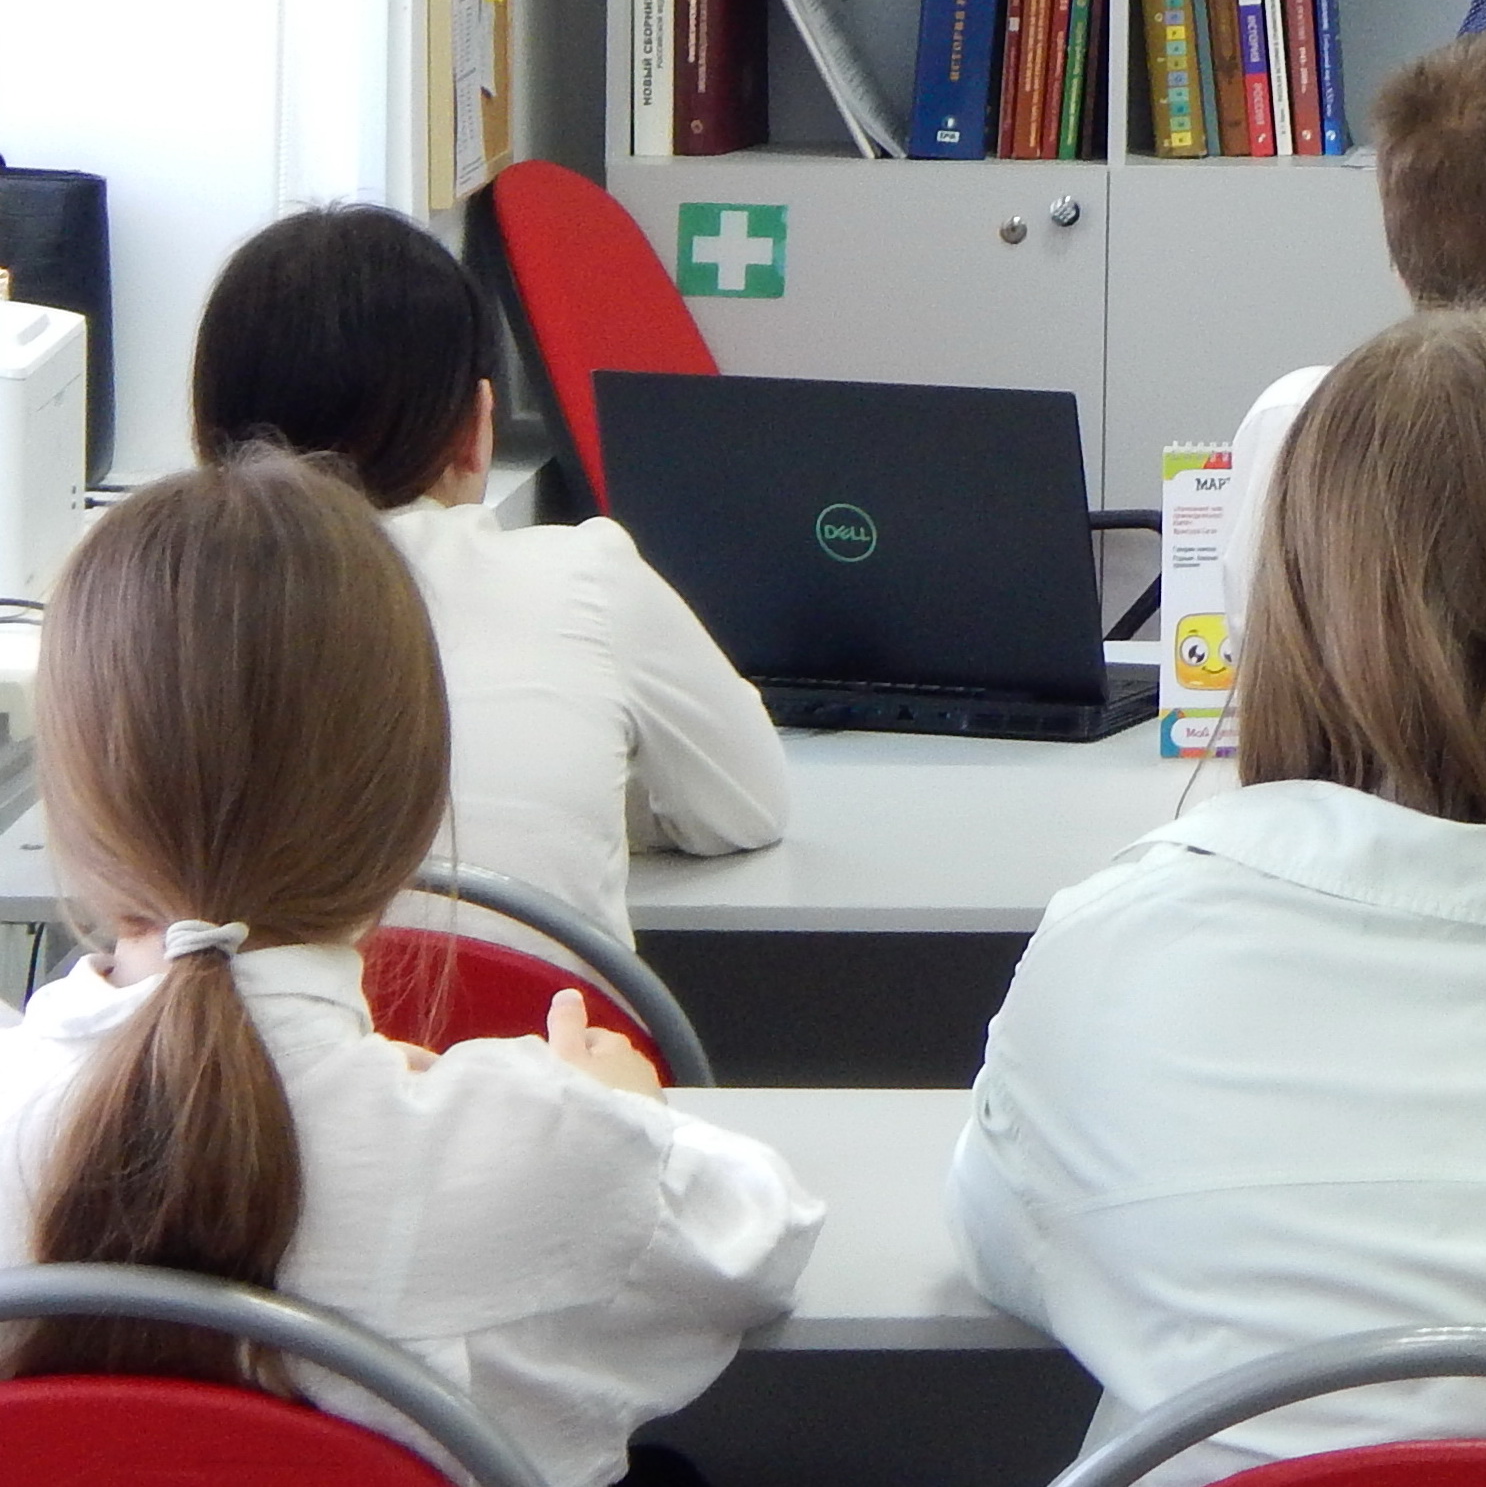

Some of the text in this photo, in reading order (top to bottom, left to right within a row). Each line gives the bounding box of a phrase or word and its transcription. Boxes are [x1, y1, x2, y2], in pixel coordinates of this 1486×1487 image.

[948, 9, 966, 82] ИСТОРИЯ
[642, 58, 654, 107] НОВЫЙ
[823, 524, 871, 542] DELL
